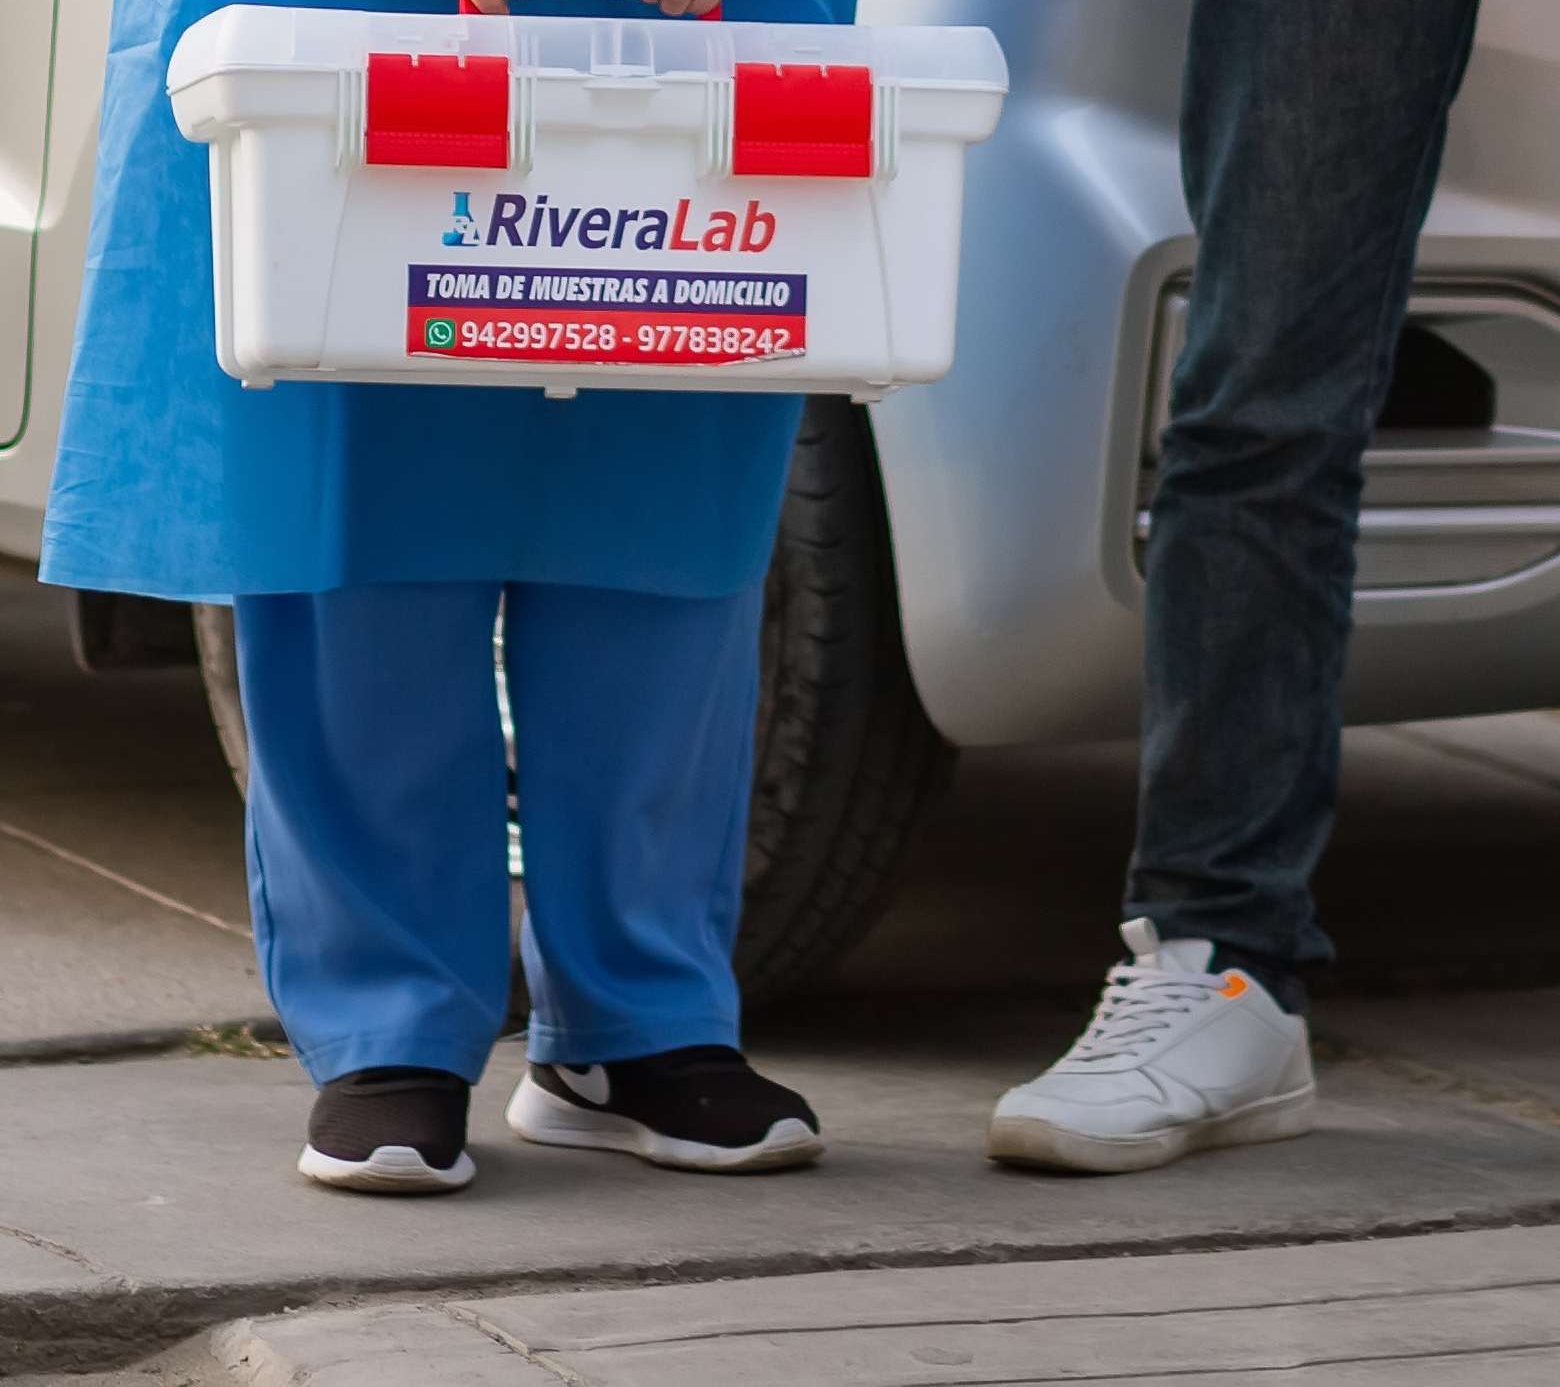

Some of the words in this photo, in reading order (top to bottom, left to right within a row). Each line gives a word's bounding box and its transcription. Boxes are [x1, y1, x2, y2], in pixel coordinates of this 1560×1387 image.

[485, 193, 777, 253] RiveraLab
[426, 273, 490, 300] TOMA
[496, 274, 526, 301] DE
[528, 275, 648, 304] MUESTRAS
[651, 278, 669, 304] A
[673, 279, 791, 307] DOMICILIO
[460, 321, 617, 351] 942997528
[637, 324, 791, 354] 977838242
